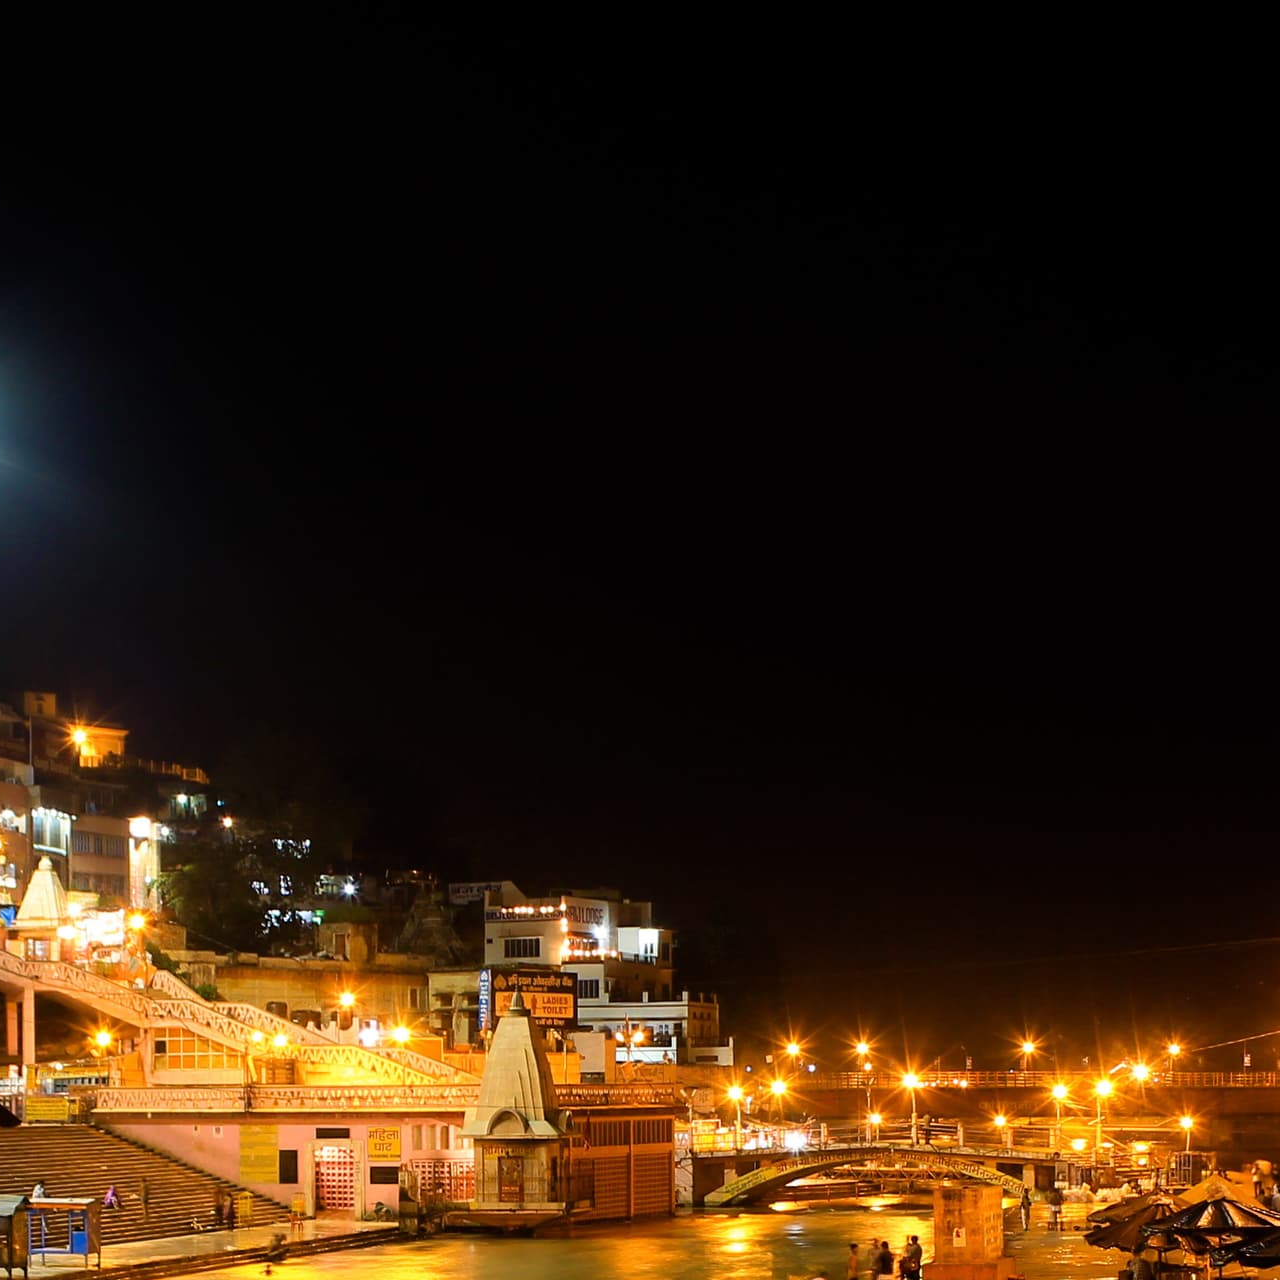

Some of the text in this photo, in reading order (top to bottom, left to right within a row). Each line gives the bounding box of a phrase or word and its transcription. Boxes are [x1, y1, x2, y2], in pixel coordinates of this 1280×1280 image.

[542, 996, 568, 1005] LADIES
[542, 1006, 568, 1015] TOILET
[369, 1128, 399, 1142] महिला
[374, 1142, 393, 1152] घाट
